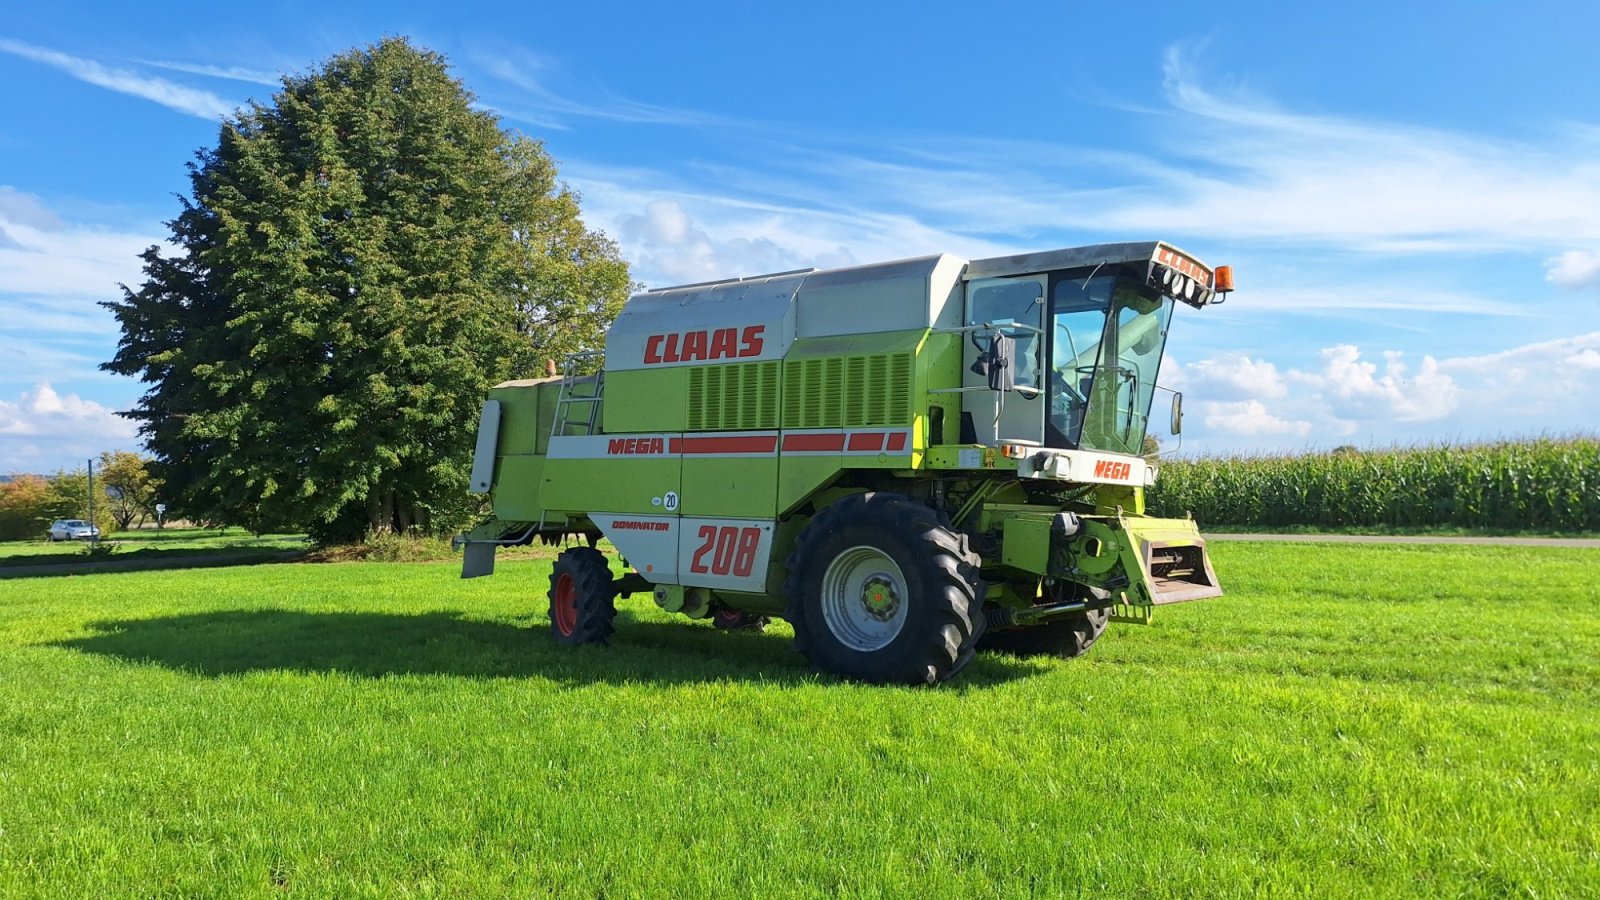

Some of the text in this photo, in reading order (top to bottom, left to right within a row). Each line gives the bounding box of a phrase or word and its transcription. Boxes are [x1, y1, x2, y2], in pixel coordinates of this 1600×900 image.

[1158, 248, 1209, 285] CLAAS
[644, 325, 765, 364] CLAAS
[608, 437, 664, 454] MEGA
[1094, 459, 1132, 480] MEGA
[666, 494, 676, 508] 20
[612, 520, 669, 531] DOMINATOR
[690, 525, 760, 577] 208
